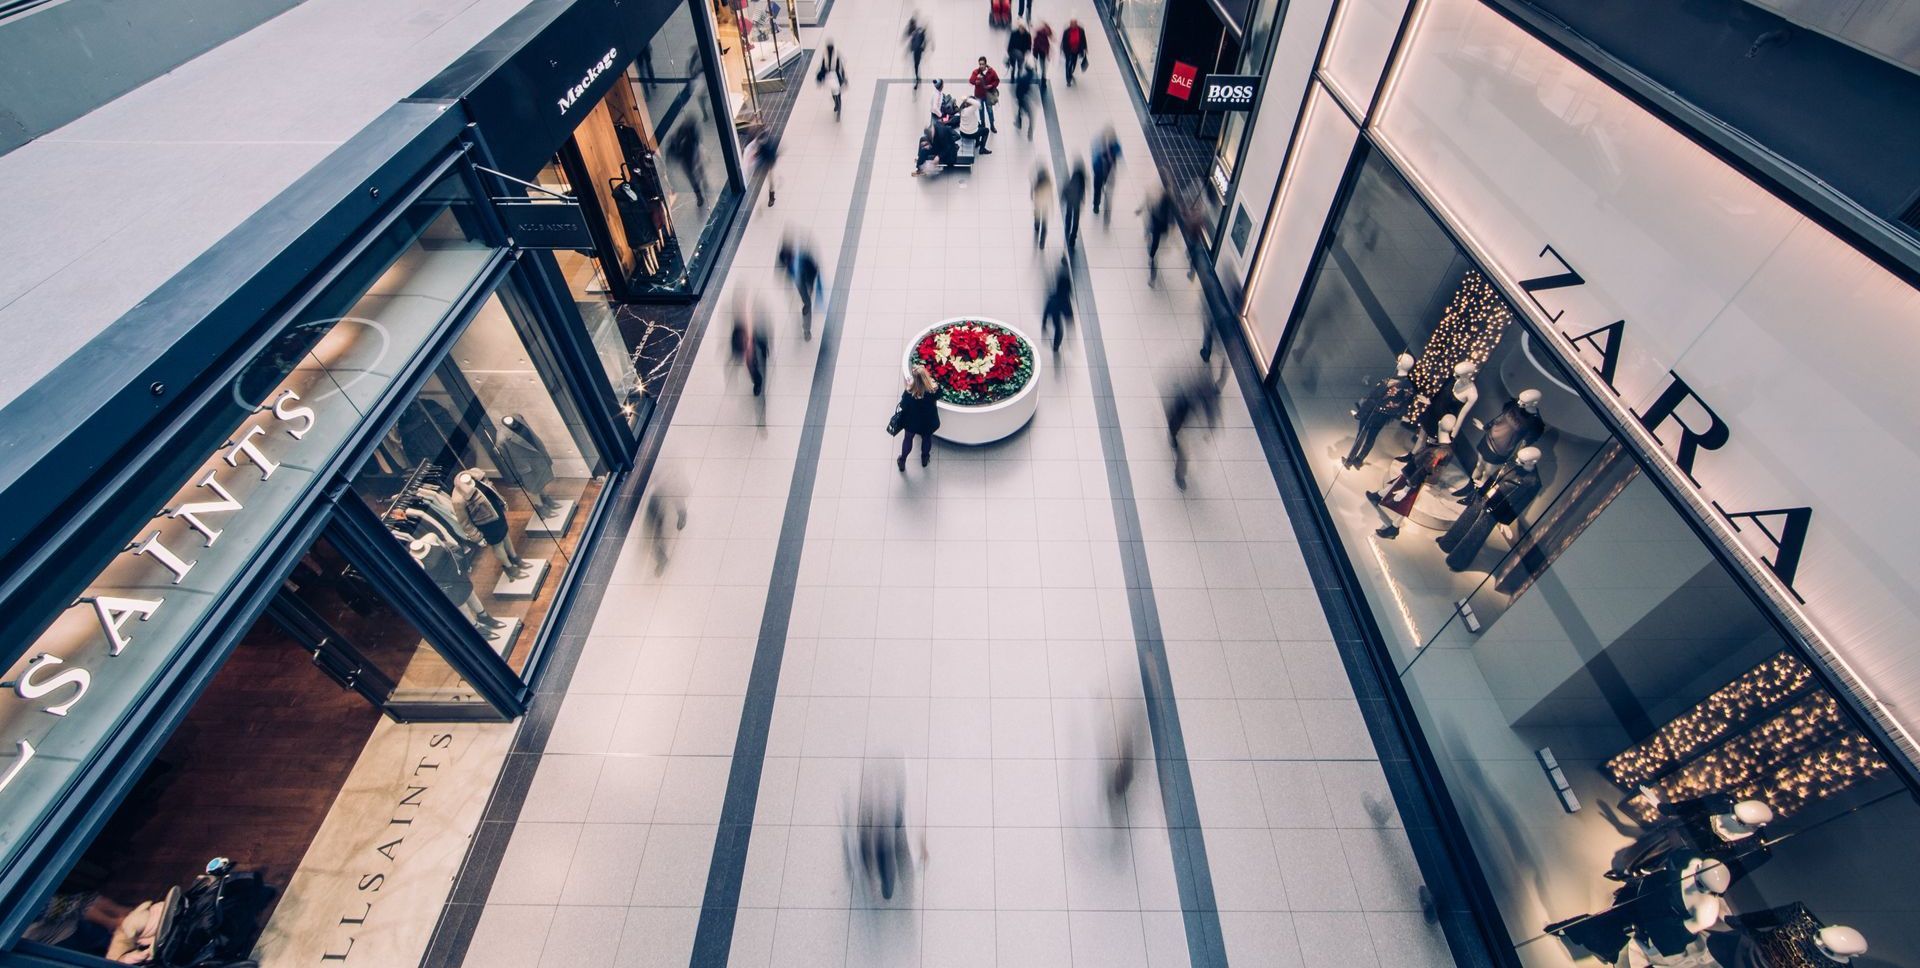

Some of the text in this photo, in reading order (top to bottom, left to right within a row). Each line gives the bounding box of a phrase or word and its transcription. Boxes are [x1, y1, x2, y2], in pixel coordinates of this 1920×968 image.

[557, 47, 617, 115] Mackage
[1171, 74, 1193, 89] SALE
[1208, 85, 1253, 99] BOSS
[518, 223, 578, 231] ALLSAINTS
[629, 320, 655, 368] ackage
[1518, 244, 1812, 605] ZARA
[320, 733, 453, 963] LLSAINTS
